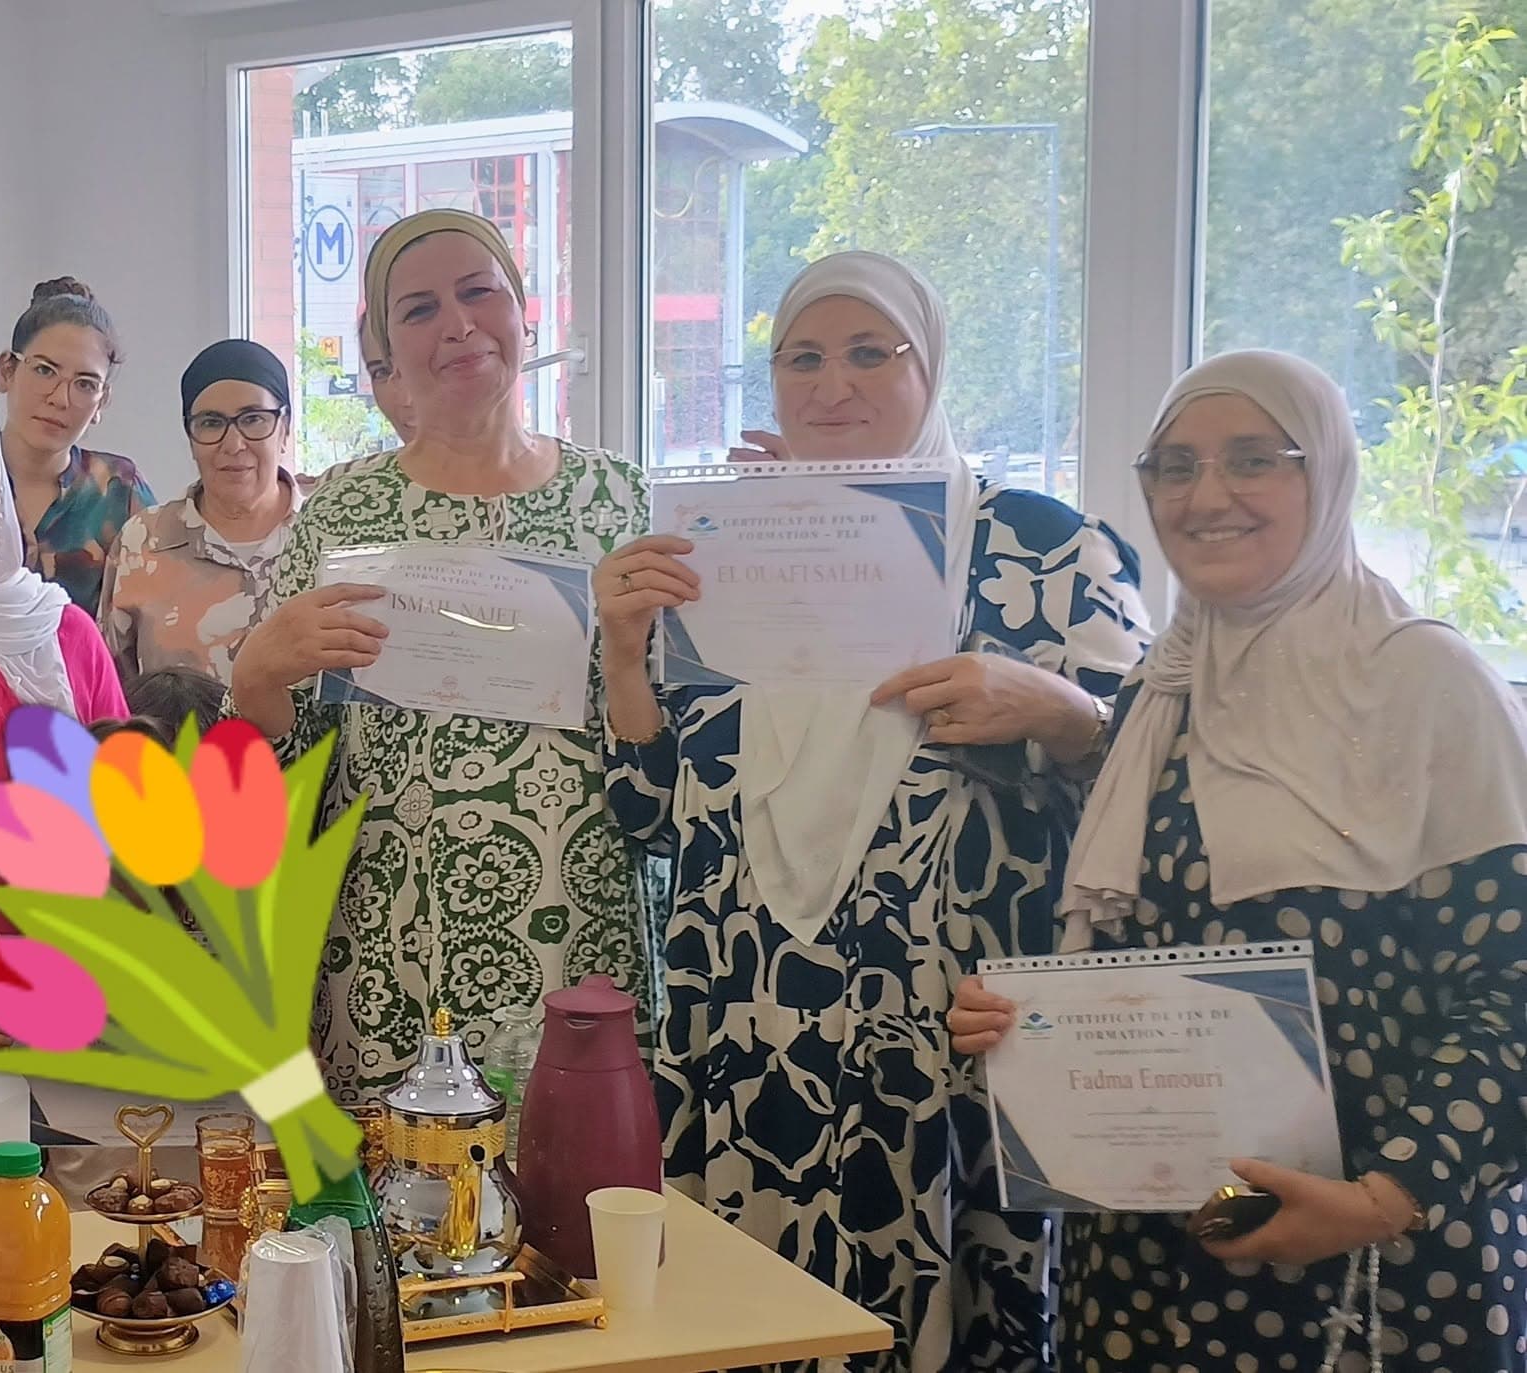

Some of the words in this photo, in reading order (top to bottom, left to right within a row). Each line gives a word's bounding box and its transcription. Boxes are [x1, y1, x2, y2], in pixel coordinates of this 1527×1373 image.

[315, 221, 344, 265] M
[723, 515, 803, 528] CERTIFICAT
[809, 515, 825, 525] DE
[831, 514, 855, 525] FIN
[860, 513, 878, 524] DE
[738, 530, 819, 541] FORMATION
[836, 529, 861, 539] FLE
[717, 565, 738, 584] EL
[813, 562, 883, 584] SALHA
[1057, 1012, 1144, 1025] CERTIFICAT
[1211, 1009, 1233, 1020] DE
[1076, 1028, 1165, 1041] FORMATION
[1067, 1068, 1133, 1091] Fadma
[1139, 1065, 1224, 1089] Ennouri
